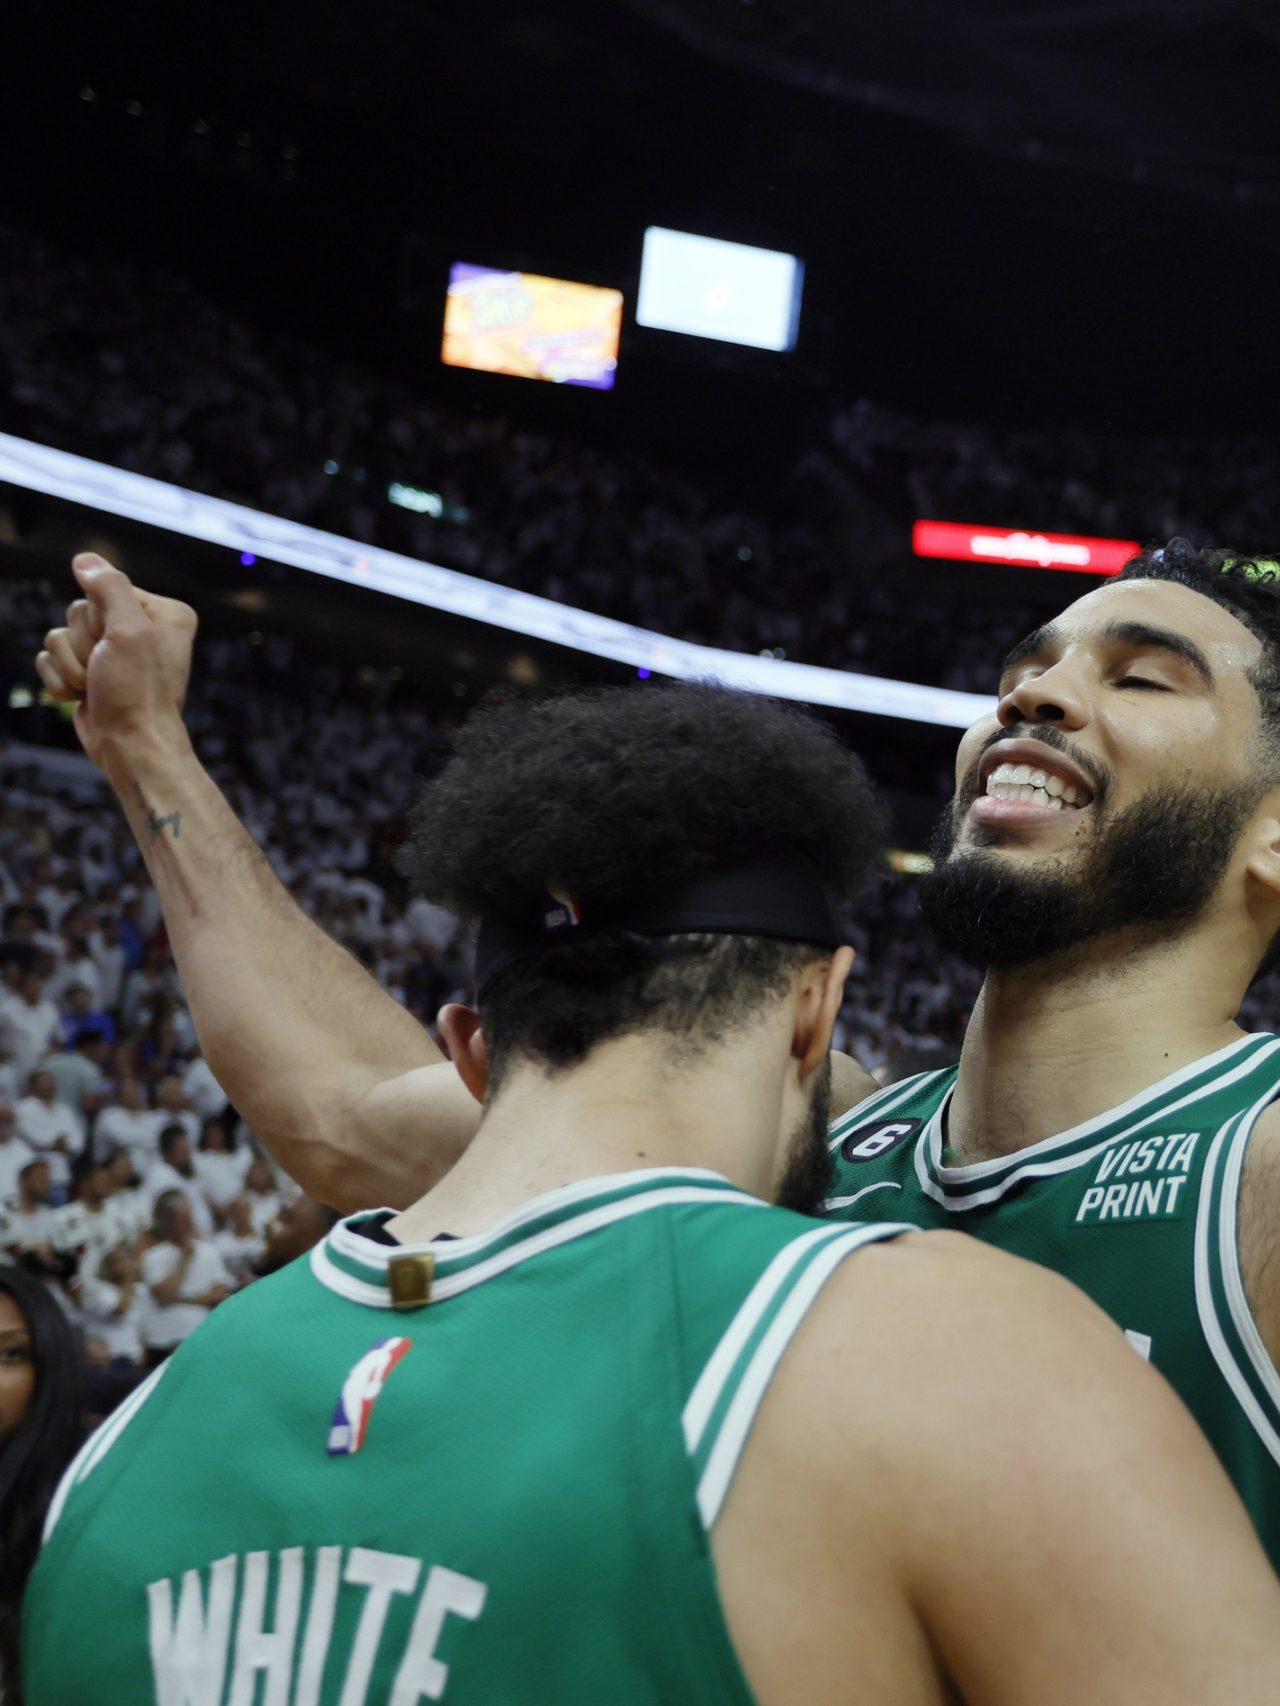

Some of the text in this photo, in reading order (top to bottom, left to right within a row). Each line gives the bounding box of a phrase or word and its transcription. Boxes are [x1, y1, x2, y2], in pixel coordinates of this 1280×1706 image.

[852, 1123, 913, 1157] 6
[1094, 1132, 1201, 1184] VISTA
[1075, 1175, 1187, 1222] PRINT
